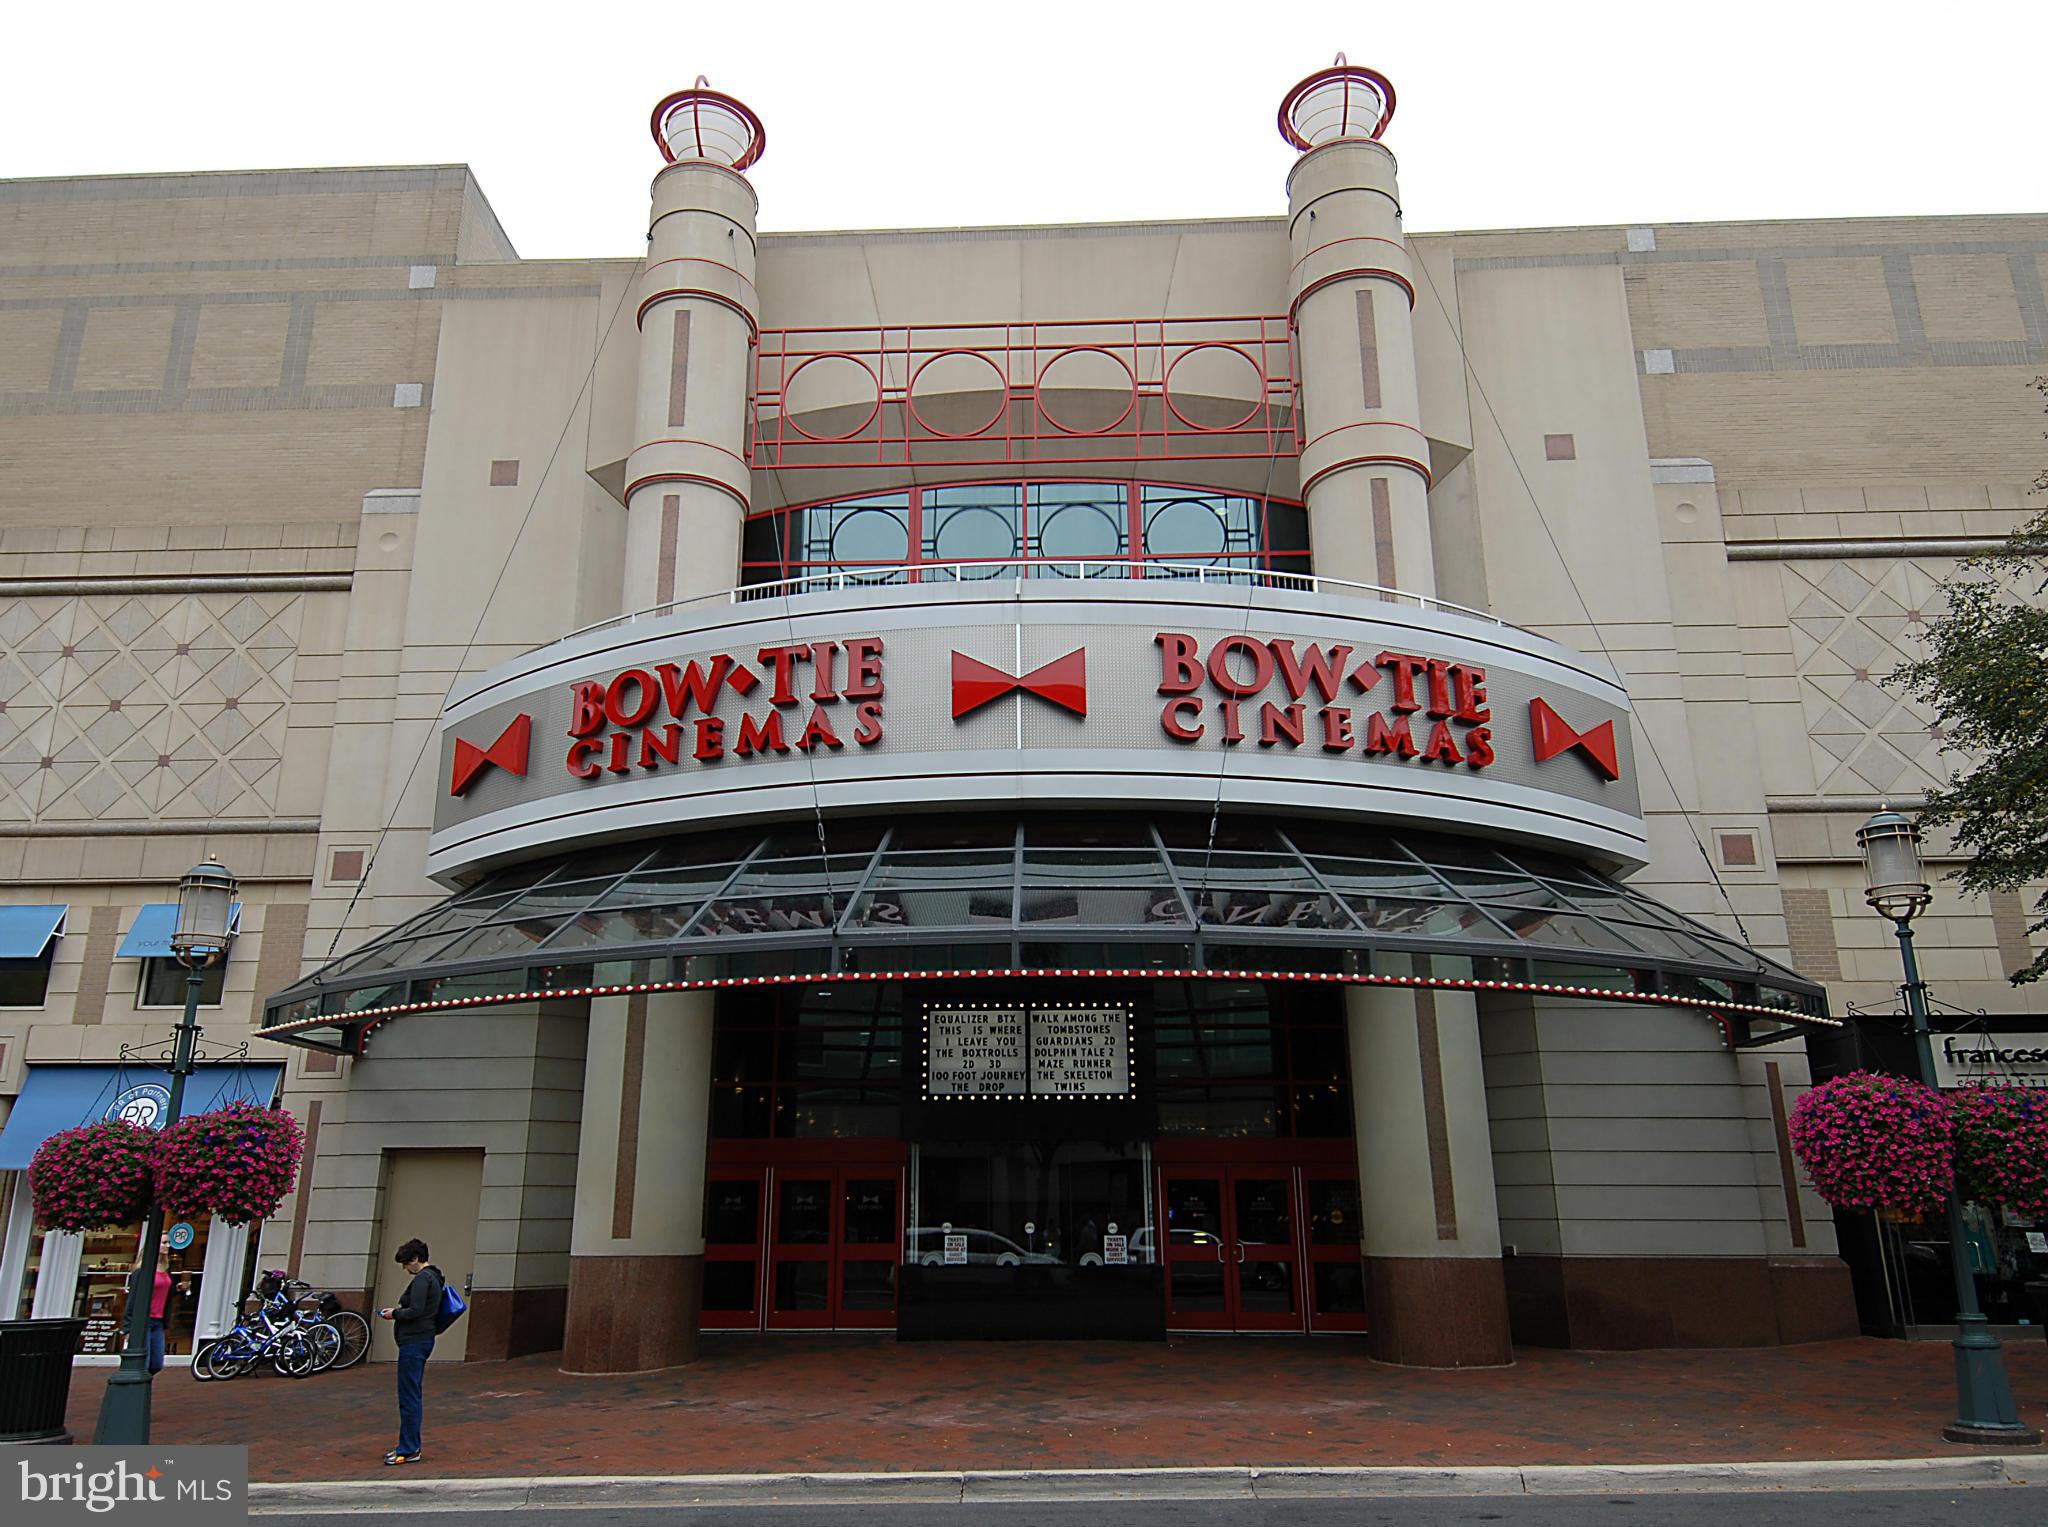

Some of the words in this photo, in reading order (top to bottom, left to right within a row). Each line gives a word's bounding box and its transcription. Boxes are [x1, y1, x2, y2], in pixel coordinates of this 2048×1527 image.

[1154, 632, 1354, 705] BOW
[1376, 650, 1491, 727] TIE
[567, 653, 735, 739] BOW
[757, 637, 884, 706] TIE
[1160, 696, 1495, 770] CINEMAS
[566, 702, 884, 780] CINEMAS
[934, 1014, 988, 1024] EQUALIZER
[998, 1014, 1016, 1024] BTX
[1032, 1014, 1059, 1023] WALK
[1063, 1014, 1097, 1023] AMONG
[1102, 1014, 1120, 1022] THE
[940, 1026, 962, 1035] THIS
[973, 1026, 983, 1034] IS
[990, 1026, 1022, 1034] WHERE
[1048, 1025, 1110, 1034] TOMBSTONES
[946, 1038, 949, 1046] I
[958, 1037, 988, 1046] LEAVE
[996, 1037, 1016, 1046] YOU
[1036, 1036, 1093, 1046] GUARDIANS
[1104, 1036, 1116, 1045] 2D
[936, 1049, 954, 1058] THE
[962, 1048, 1018, 1058] BOXTROLLS
[1035, 1048, 1077, 1057] DOLPHIN
[1081, 1048, 1105, 1057] TALE
[1109, 1048, 1114, 1057] 2
[1943, 1036, 2047, 1064] frances
[963, 1060, 975, 1069] 2D
[989, 1060, 1002, 1068] 3D
[1038, 1060, 1064, 1068] MAZE
[1073, 1060, 1112, 1068] RUNNER
[932, 1072, 949, 1080] 100
[952, 1072, 977, 1080] FOOT
[980, 1072, 1026, 1080] JOURNEY
[1037, 1071, 1055, 1080] THE
[1064, 1071, 1113, 1080] SKELETON
[952, 1083, 969, 1092] THE
[978, 1082, 1005, 1092] DROP
[1054, 1082, 1086, 1092] TWINS
[124, 1106, 154, 1126] PR
